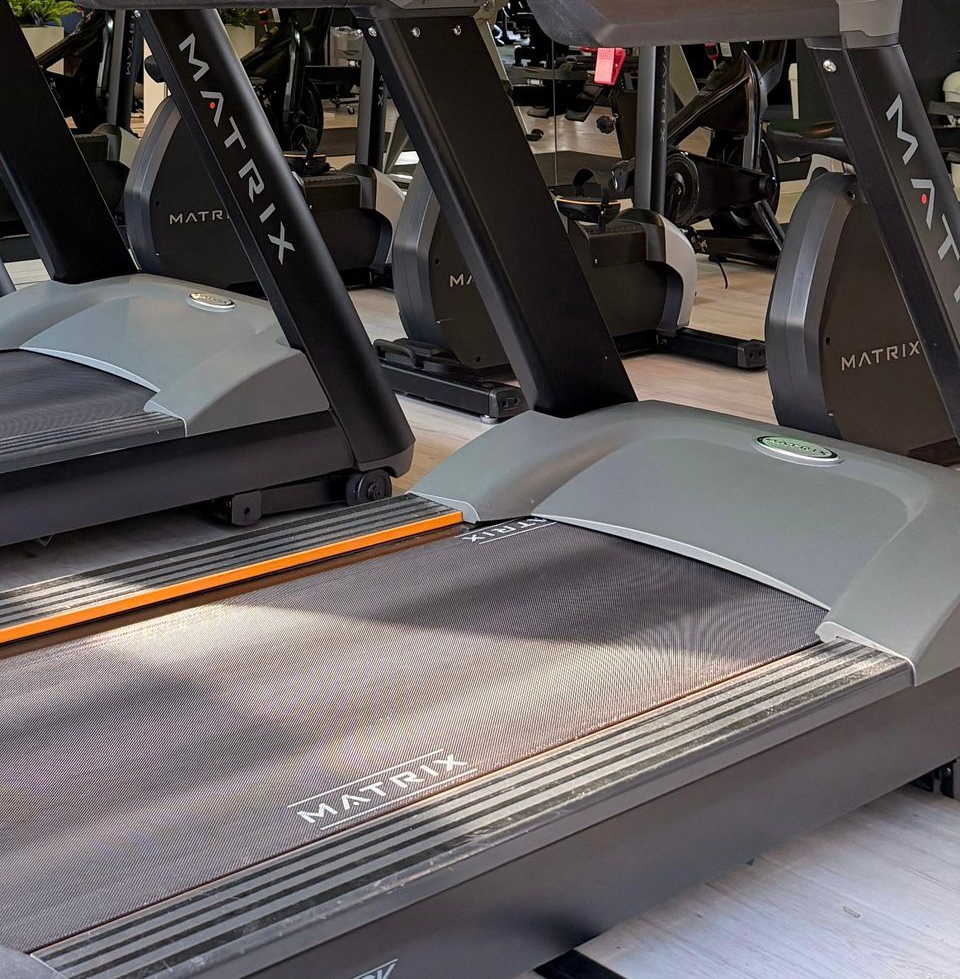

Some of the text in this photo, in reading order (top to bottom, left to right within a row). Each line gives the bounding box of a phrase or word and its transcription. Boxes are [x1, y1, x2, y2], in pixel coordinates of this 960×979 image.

[178, 32, 296, 266] MATRIX
[169, 209, 230, 225] MATR
[885, 94, 960, 303] MAT
[841, 340, 921, 372] MATRIX
[297, 754, 468, 824] MATRIX
